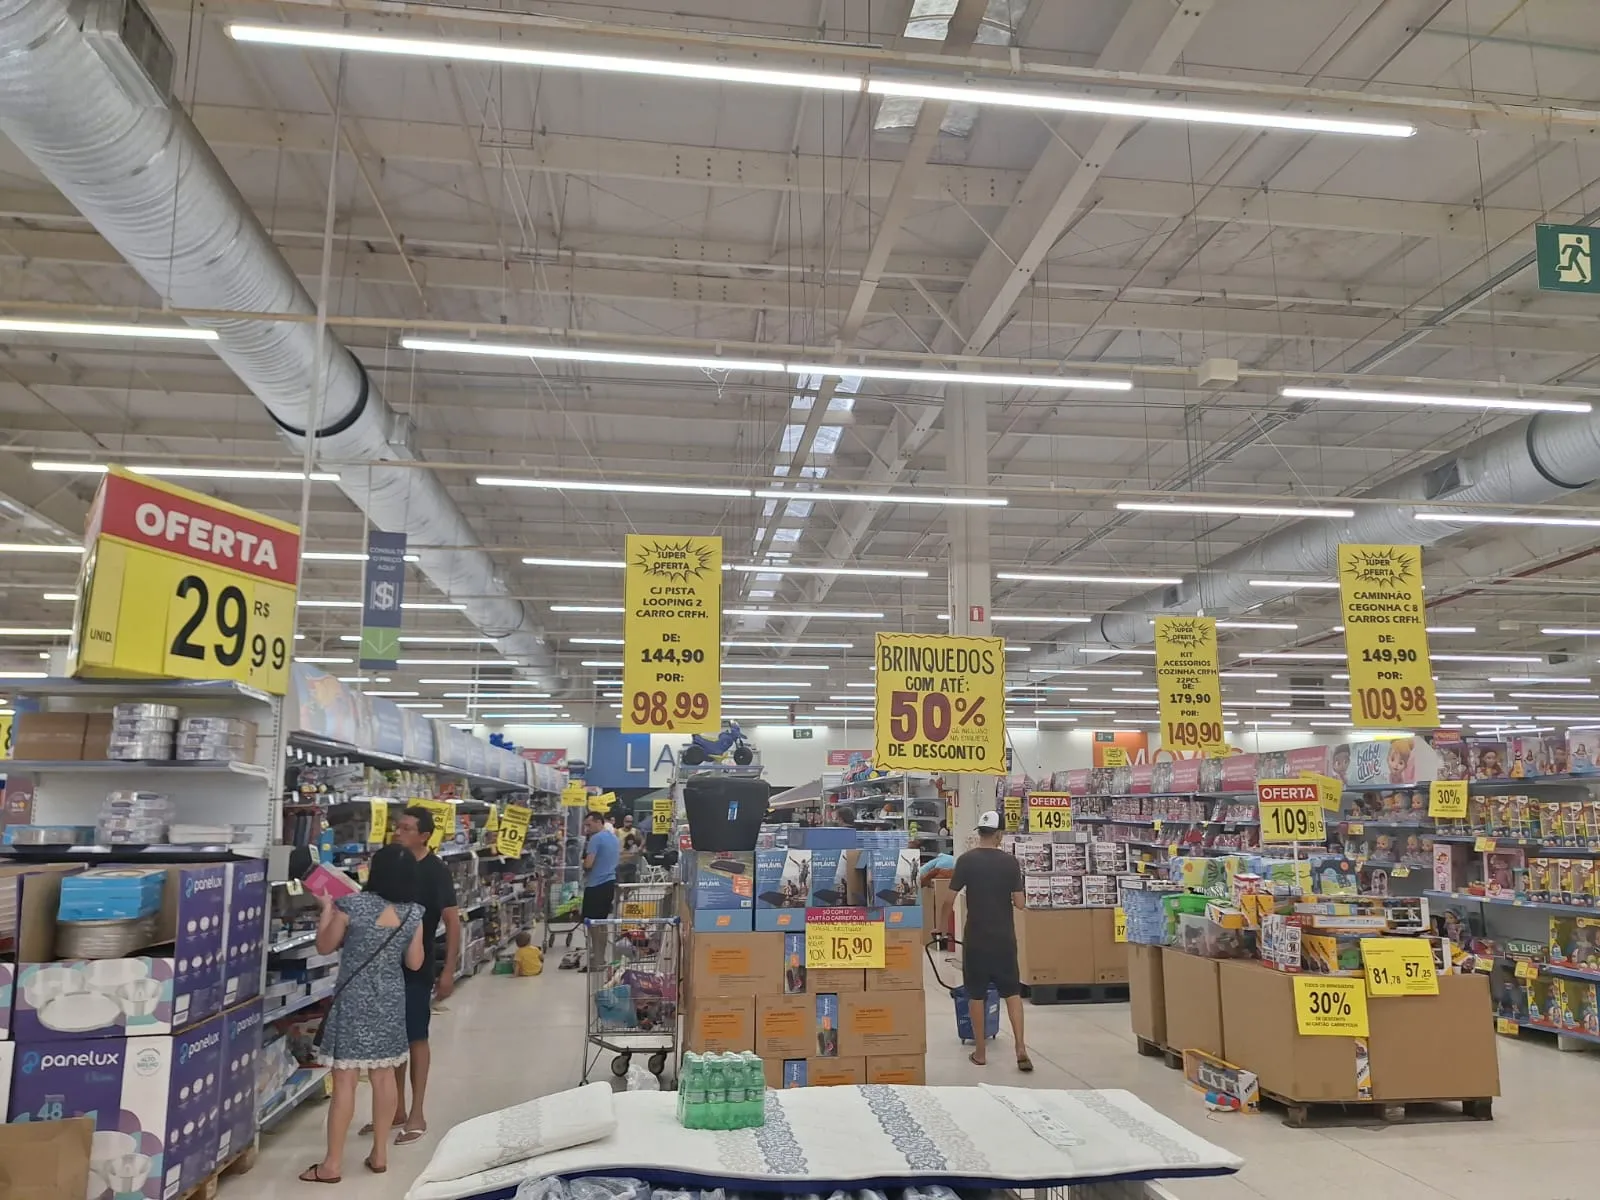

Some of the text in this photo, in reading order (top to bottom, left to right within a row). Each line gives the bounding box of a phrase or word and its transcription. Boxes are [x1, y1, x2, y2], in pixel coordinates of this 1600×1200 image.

[135, 503, 278, 570] OFERTA
[657, 551, 686, 559] SUPER
[653, 562, 690, 571] OFERTA
[1363, 568, 1394, 576] OFERTA
[650, 587, 696, 596] CJ PISTA
[1353, 590, 1411, 600] CAMINHÃO
[253, 600, 270, 619] R$
[642, 598, 703, 607] LOOPING 2
[1348, 603, 1402, 612] CEGONHA
[636, 610, 675, 618] CARRO
[1348, 615, 1390, 624] CARROS
[662, 634, 681, 643] DE:
[1378, 634, 1395, 643] DE:
[641, 649, 704, 666] 144,90
[881, 645, 995, 675] BRINQUEDOS
[1362, 649, 1417, 664] 149,90
[656, 673, 684, 682] POR:
[1377, 671, 1402, 680] POR:
[905, 676, 969, 693] COM ATÉ:
[1170, 693, 1211, 705] 179,90
[1357, 686, 1428, 722] 109,98
[631, 691, 709, 730] 98,99
[890, 691, 986, 742] 50%
[1167, 722, 1222, 748] 149,90
[889, 743, 986, 760] DE DESCONTO
[1030, 797, 1069, 806] OFERTA
[1261, 787, 1316, 800] OFERTA
[1437, 789, 1460, 805] 30%
[1036, 811, 1061, 828] 149
[1271, 808, 1308, 835] 109
[194, 876, 223, 893] panelux
[244, 872, 265, 886] panelux
[831, 937, 872, 960] 15,90
[1309, 991, 1351, 1016] 30%
[236, 1012, 261, 1033] panelux
[188, 1031, 220, 1059] panelux
[40, 1051, 120, 1071] panelux
[37, 1102, 63, 1120] 48
